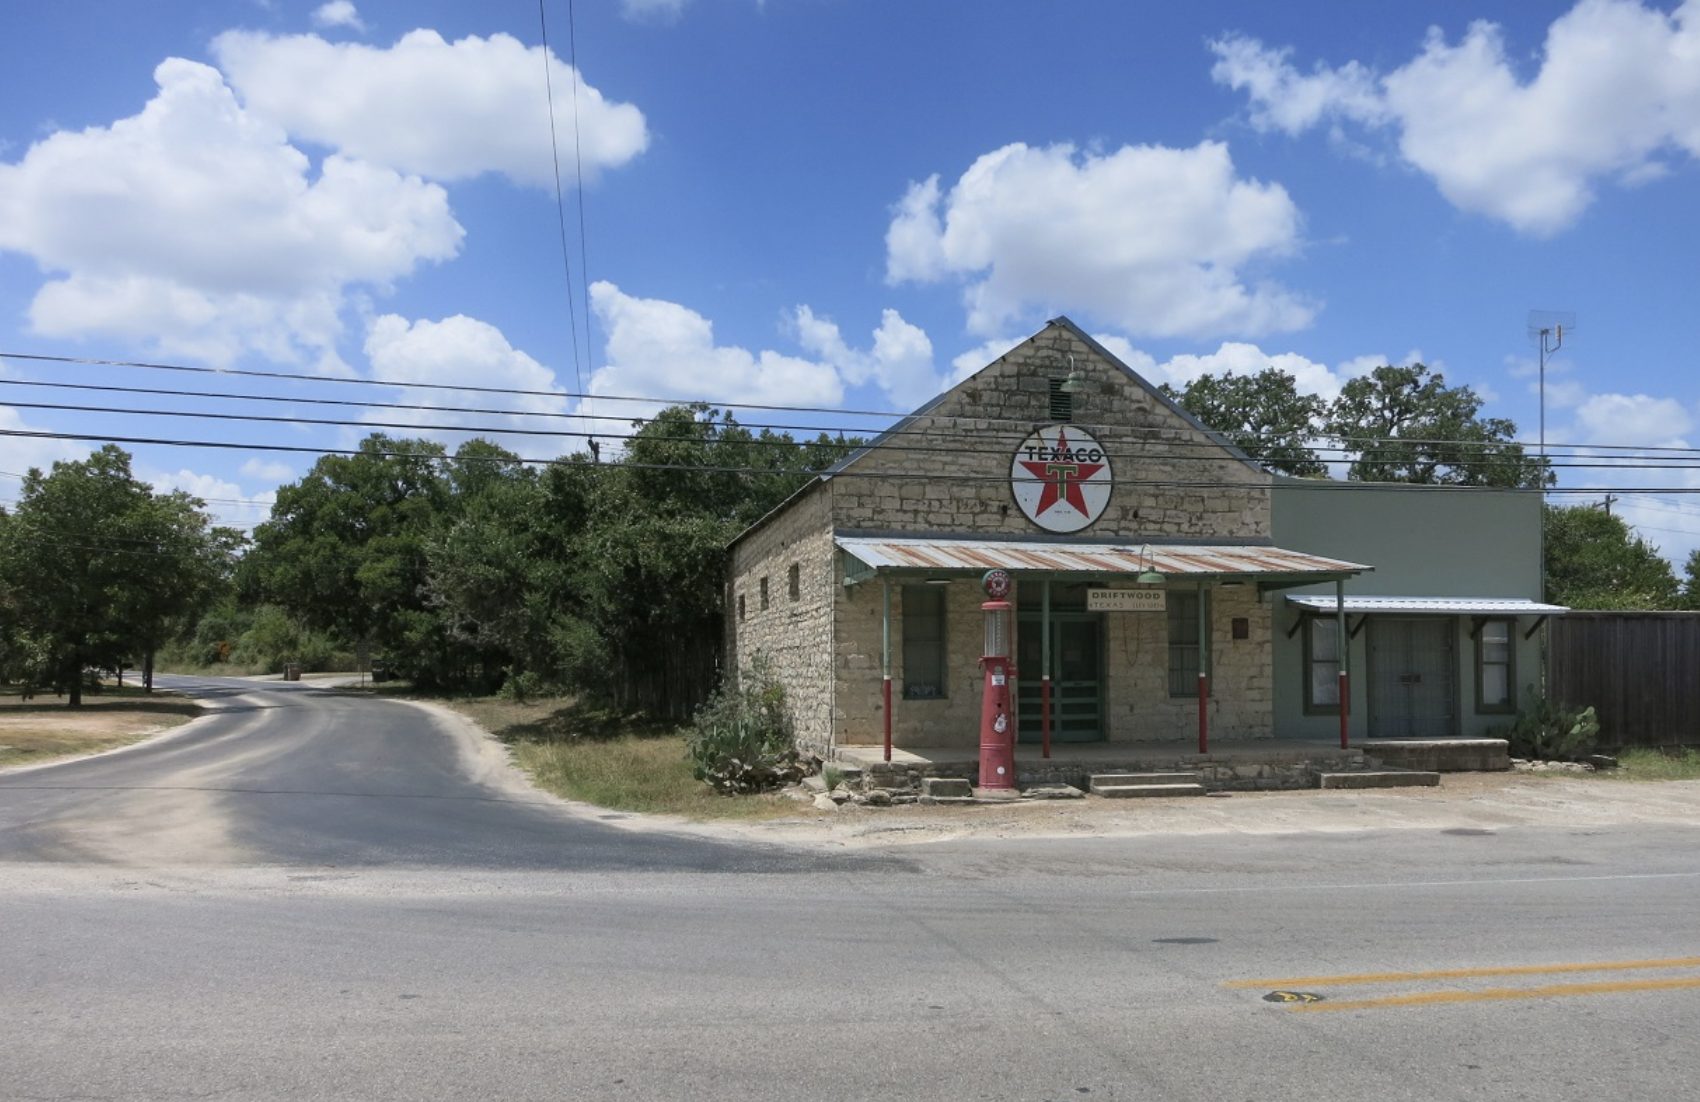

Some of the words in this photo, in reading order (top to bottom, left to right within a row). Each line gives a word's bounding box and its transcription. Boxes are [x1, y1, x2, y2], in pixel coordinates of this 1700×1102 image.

[1025, 447, 1102, 463] TEXACO
[1045, 463, 1079, 502] T
[1092, 591, 1161, 600] DRIFTWOOD
